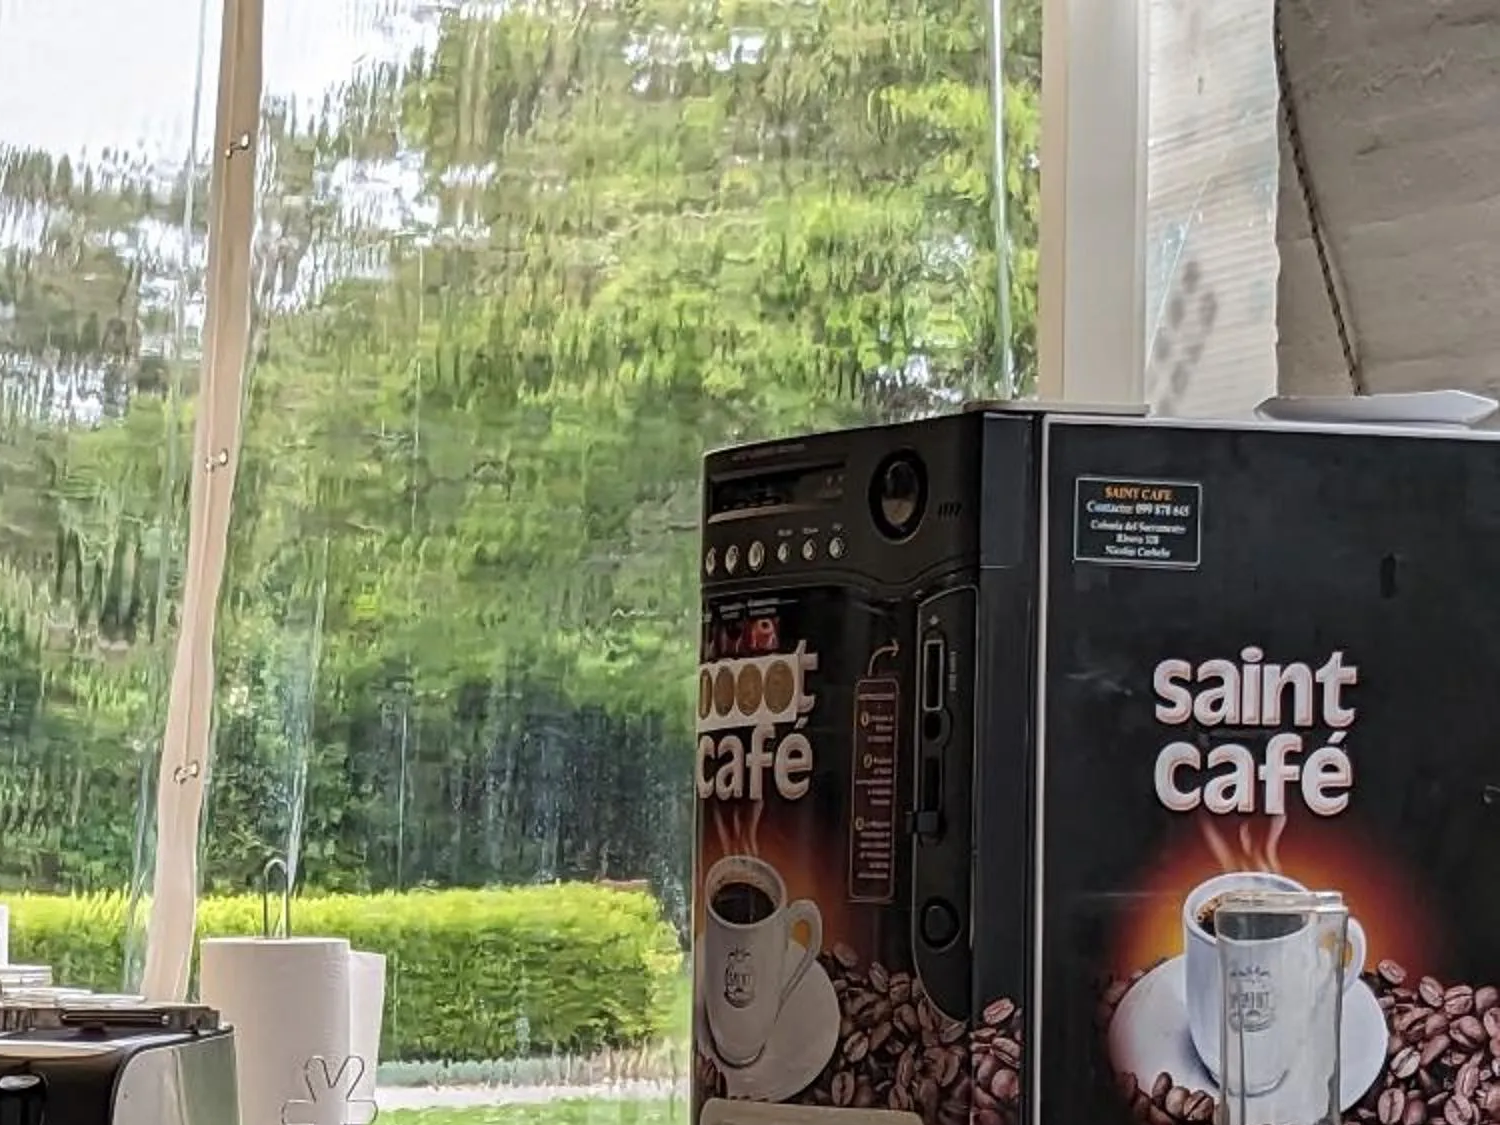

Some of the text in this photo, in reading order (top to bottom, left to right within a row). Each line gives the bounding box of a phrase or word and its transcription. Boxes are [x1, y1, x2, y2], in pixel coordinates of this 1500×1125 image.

[1105, 486, 1139, 499] SAINT
[1152, 645, 1358, 728] saint
[697, 716, 814, 801] café
[1153, 730, 1354, 817] café
